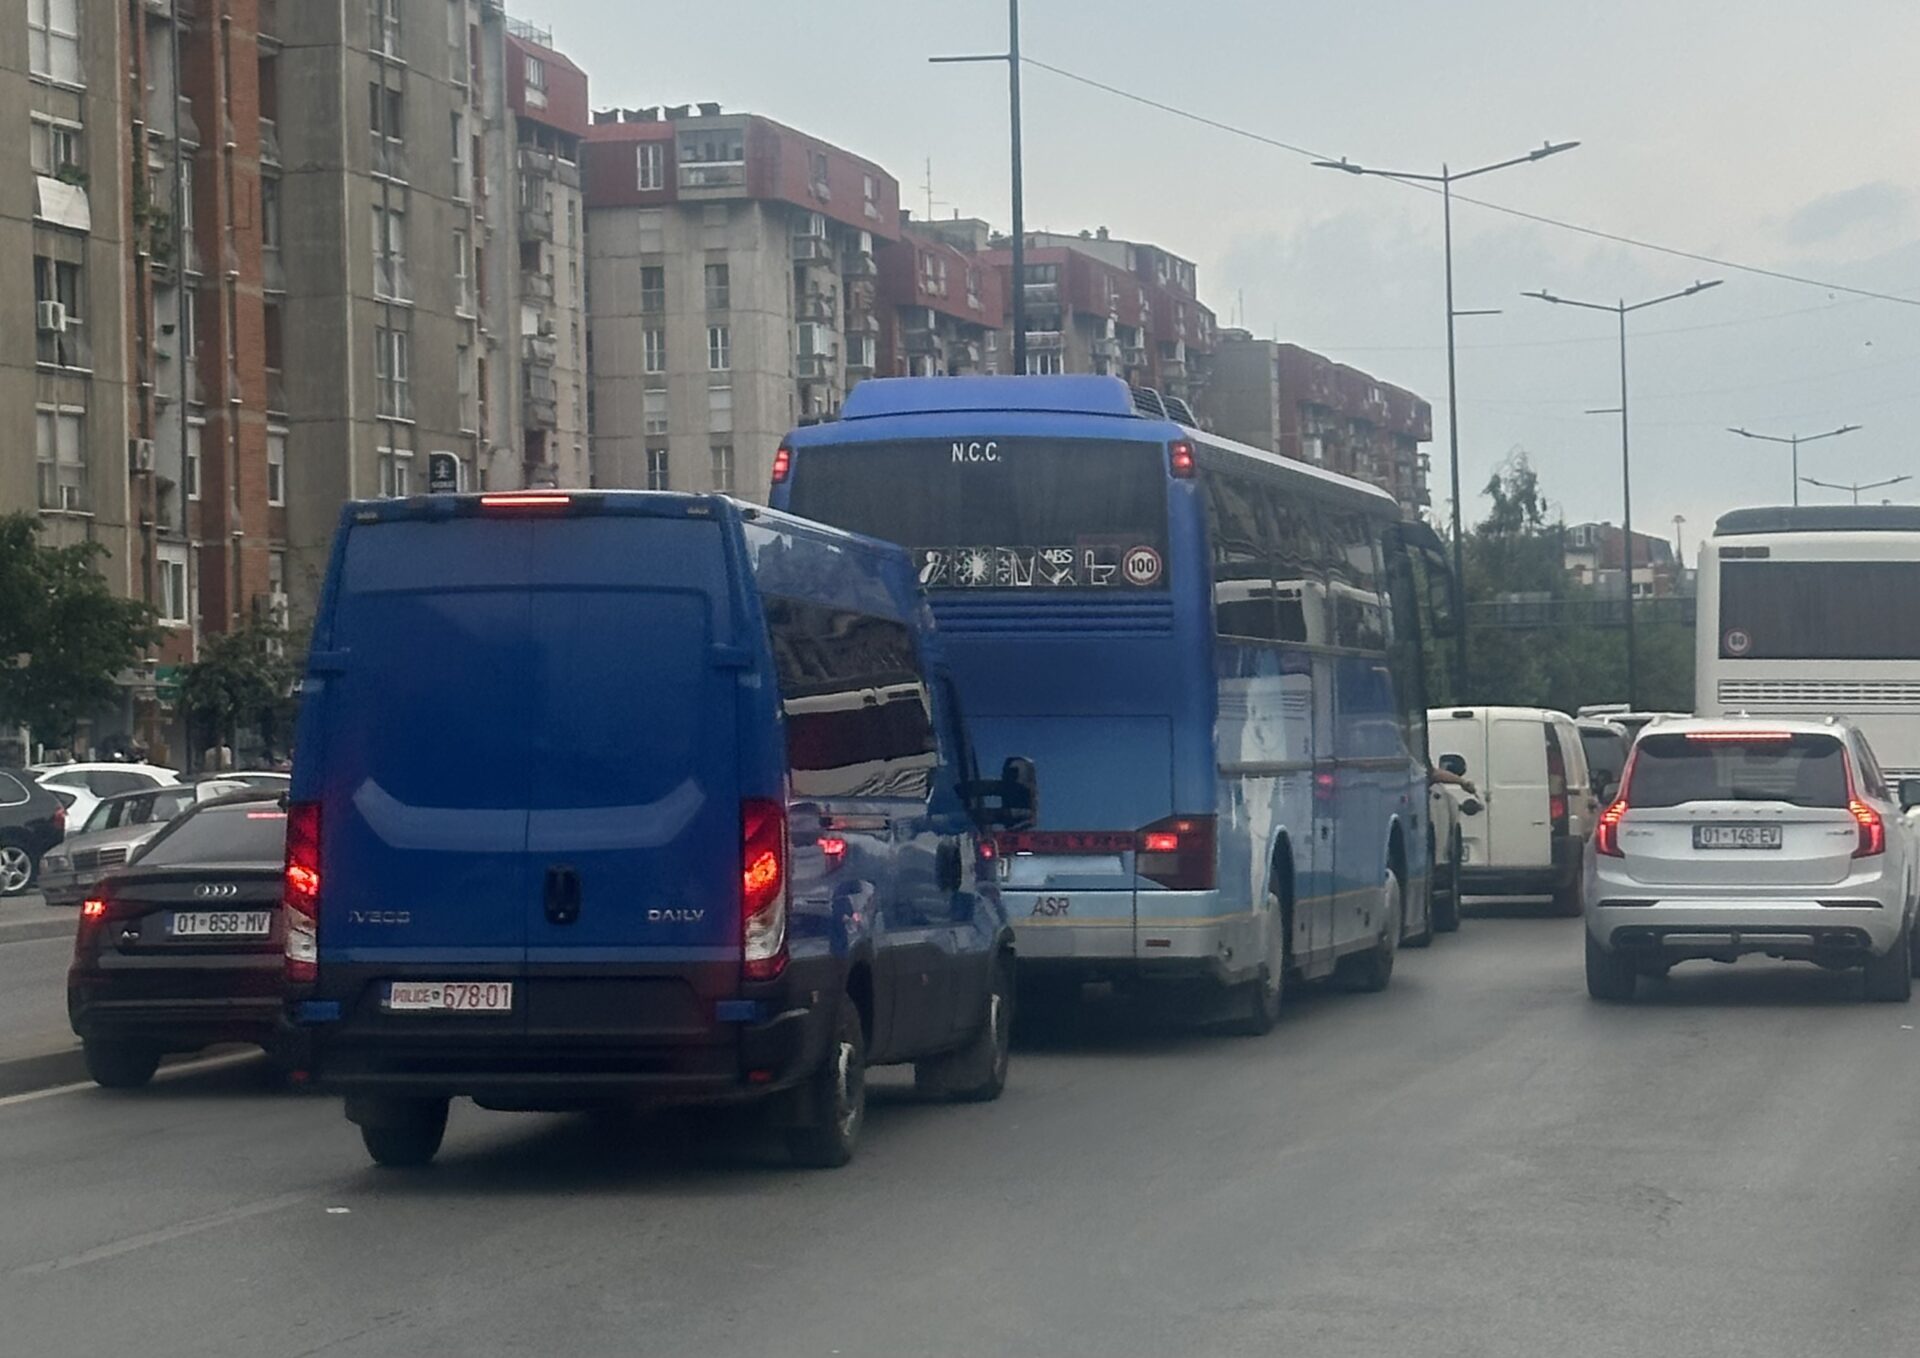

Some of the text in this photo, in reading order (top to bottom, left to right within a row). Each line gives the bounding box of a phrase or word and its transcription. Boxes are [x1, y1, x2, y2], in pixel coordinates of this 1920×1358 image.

[1044, 549, 1073, 563] ABS
[1131, 558, 1155, 573] 100
[1030, 896, 1070, 916] ASR
[348, 910, 411, 923] IVECO
[647, 909, 705, 922] DAILY
[393, 988, 431, 1003] POLICE
